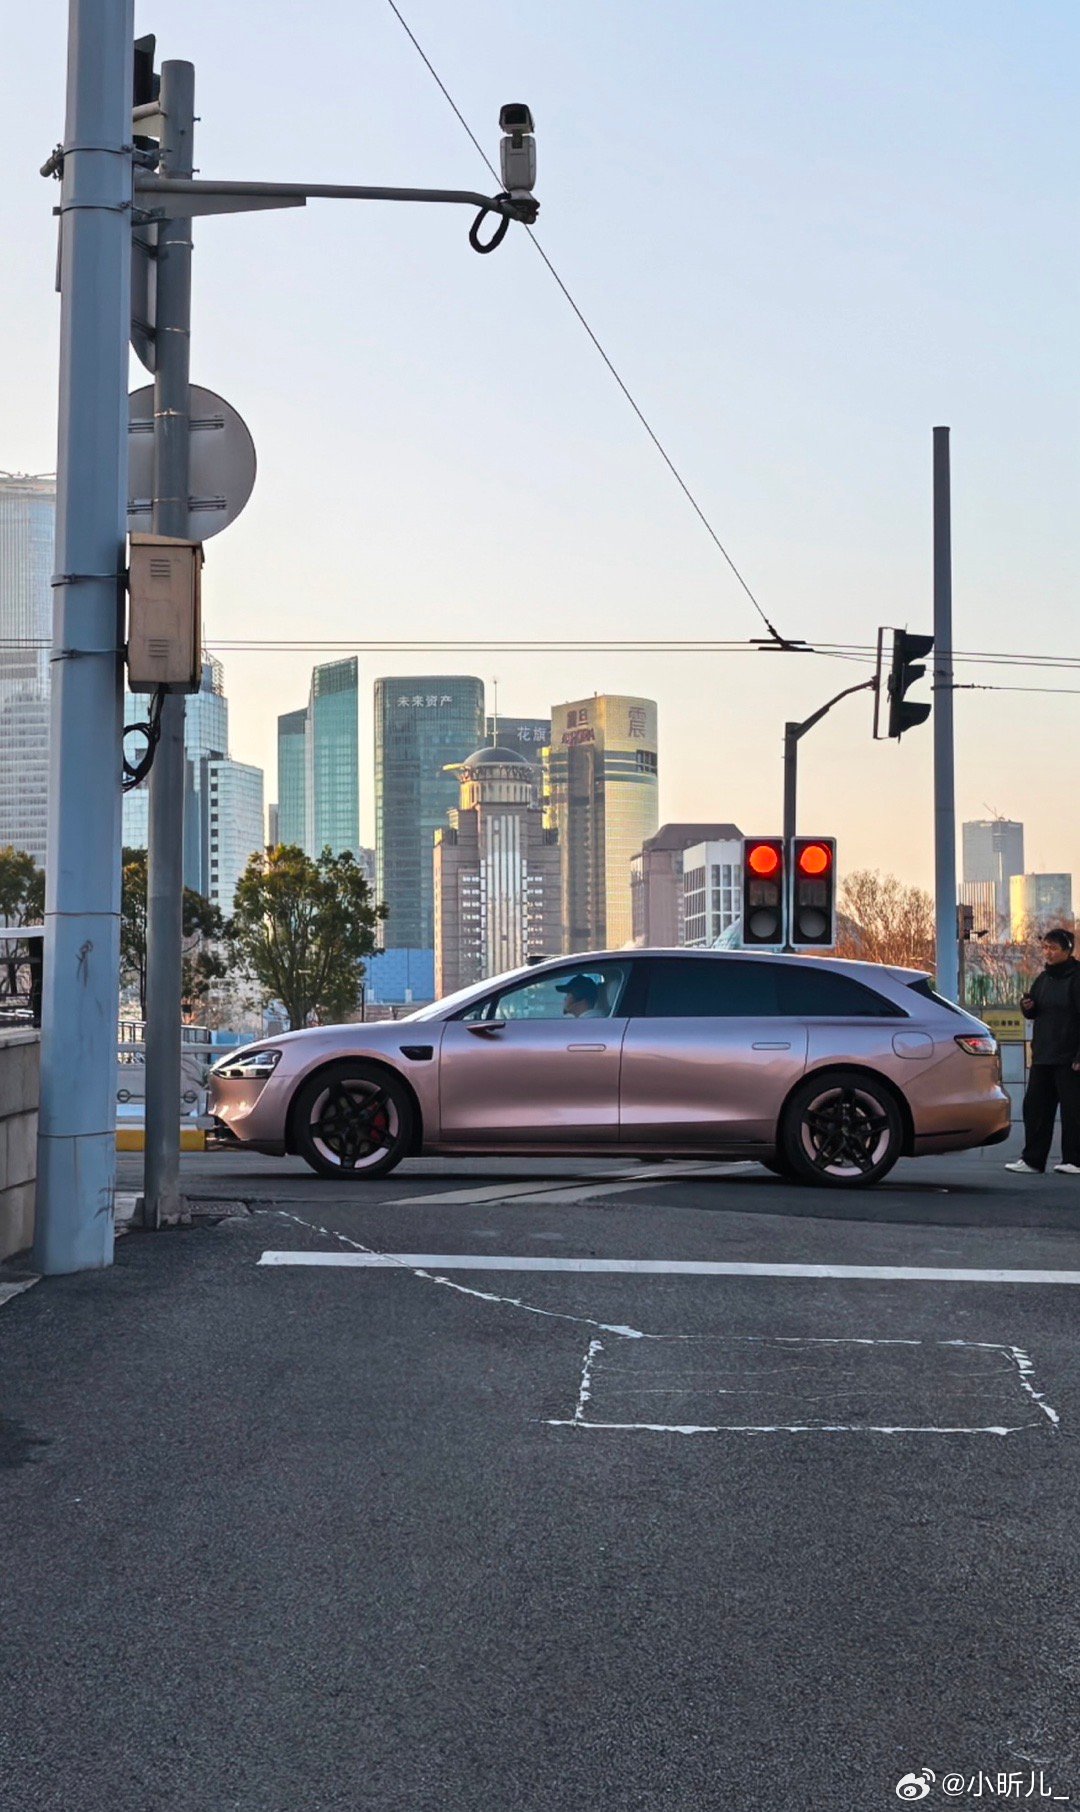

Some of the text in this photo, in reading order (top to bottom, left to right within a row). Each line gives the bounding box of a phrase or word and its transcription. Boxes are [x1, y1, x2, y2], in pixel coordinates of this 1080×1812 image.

[397, 695, 453, 708] 未来资产
[567, 708, 588, 729] 旦
[629, 706, 646, 738] 震
[517, 726, 547, 742] 花旗
